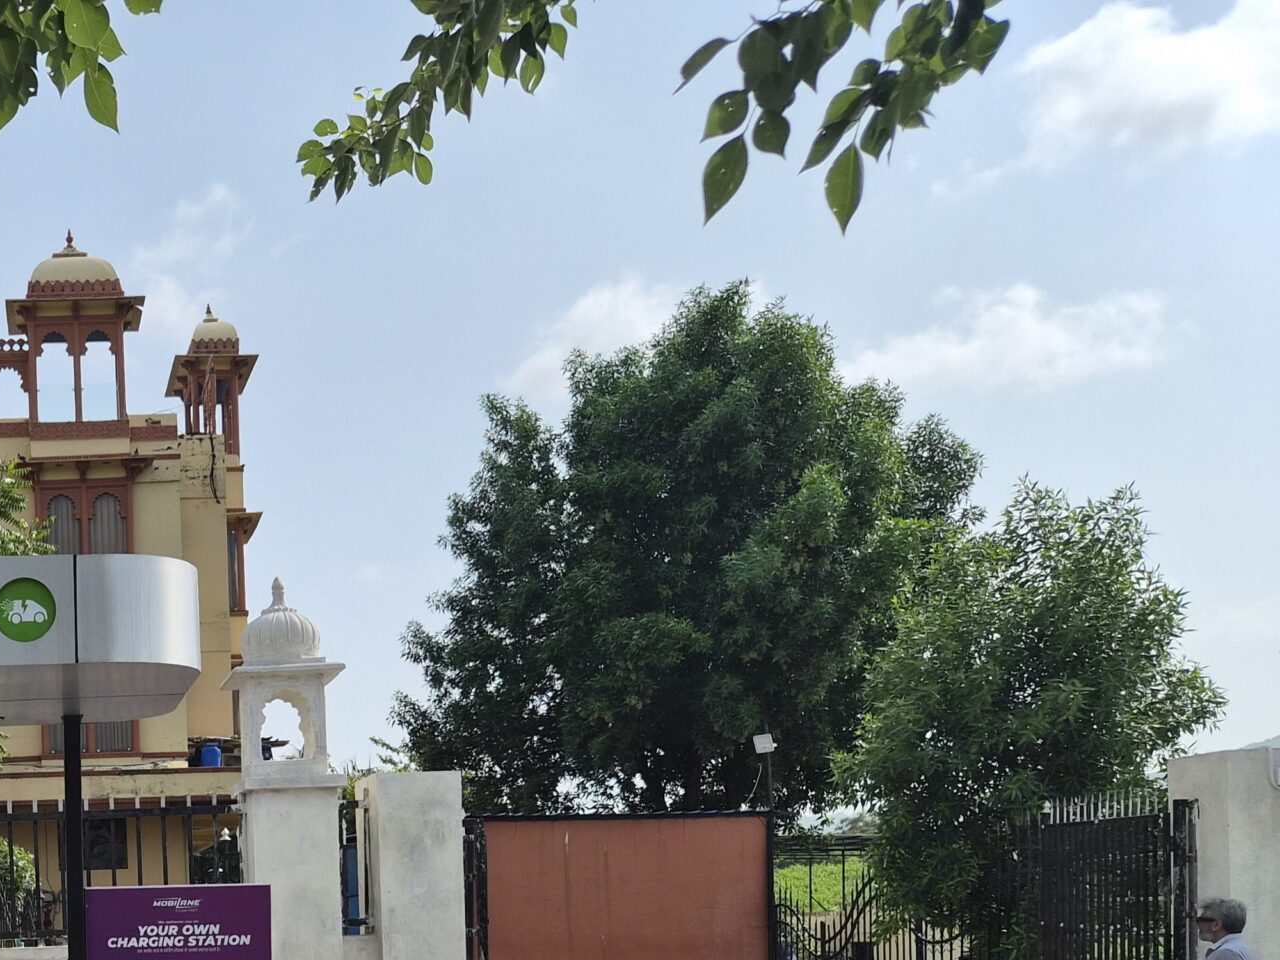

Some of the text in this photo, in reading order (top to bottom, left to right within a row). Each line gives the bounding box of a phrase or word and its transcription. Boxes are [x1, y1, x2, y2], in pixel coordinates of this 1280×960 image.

[138, 924, 220, 936] YOUR OWN
[108, 935, 252, 948] CHARGING STATION
